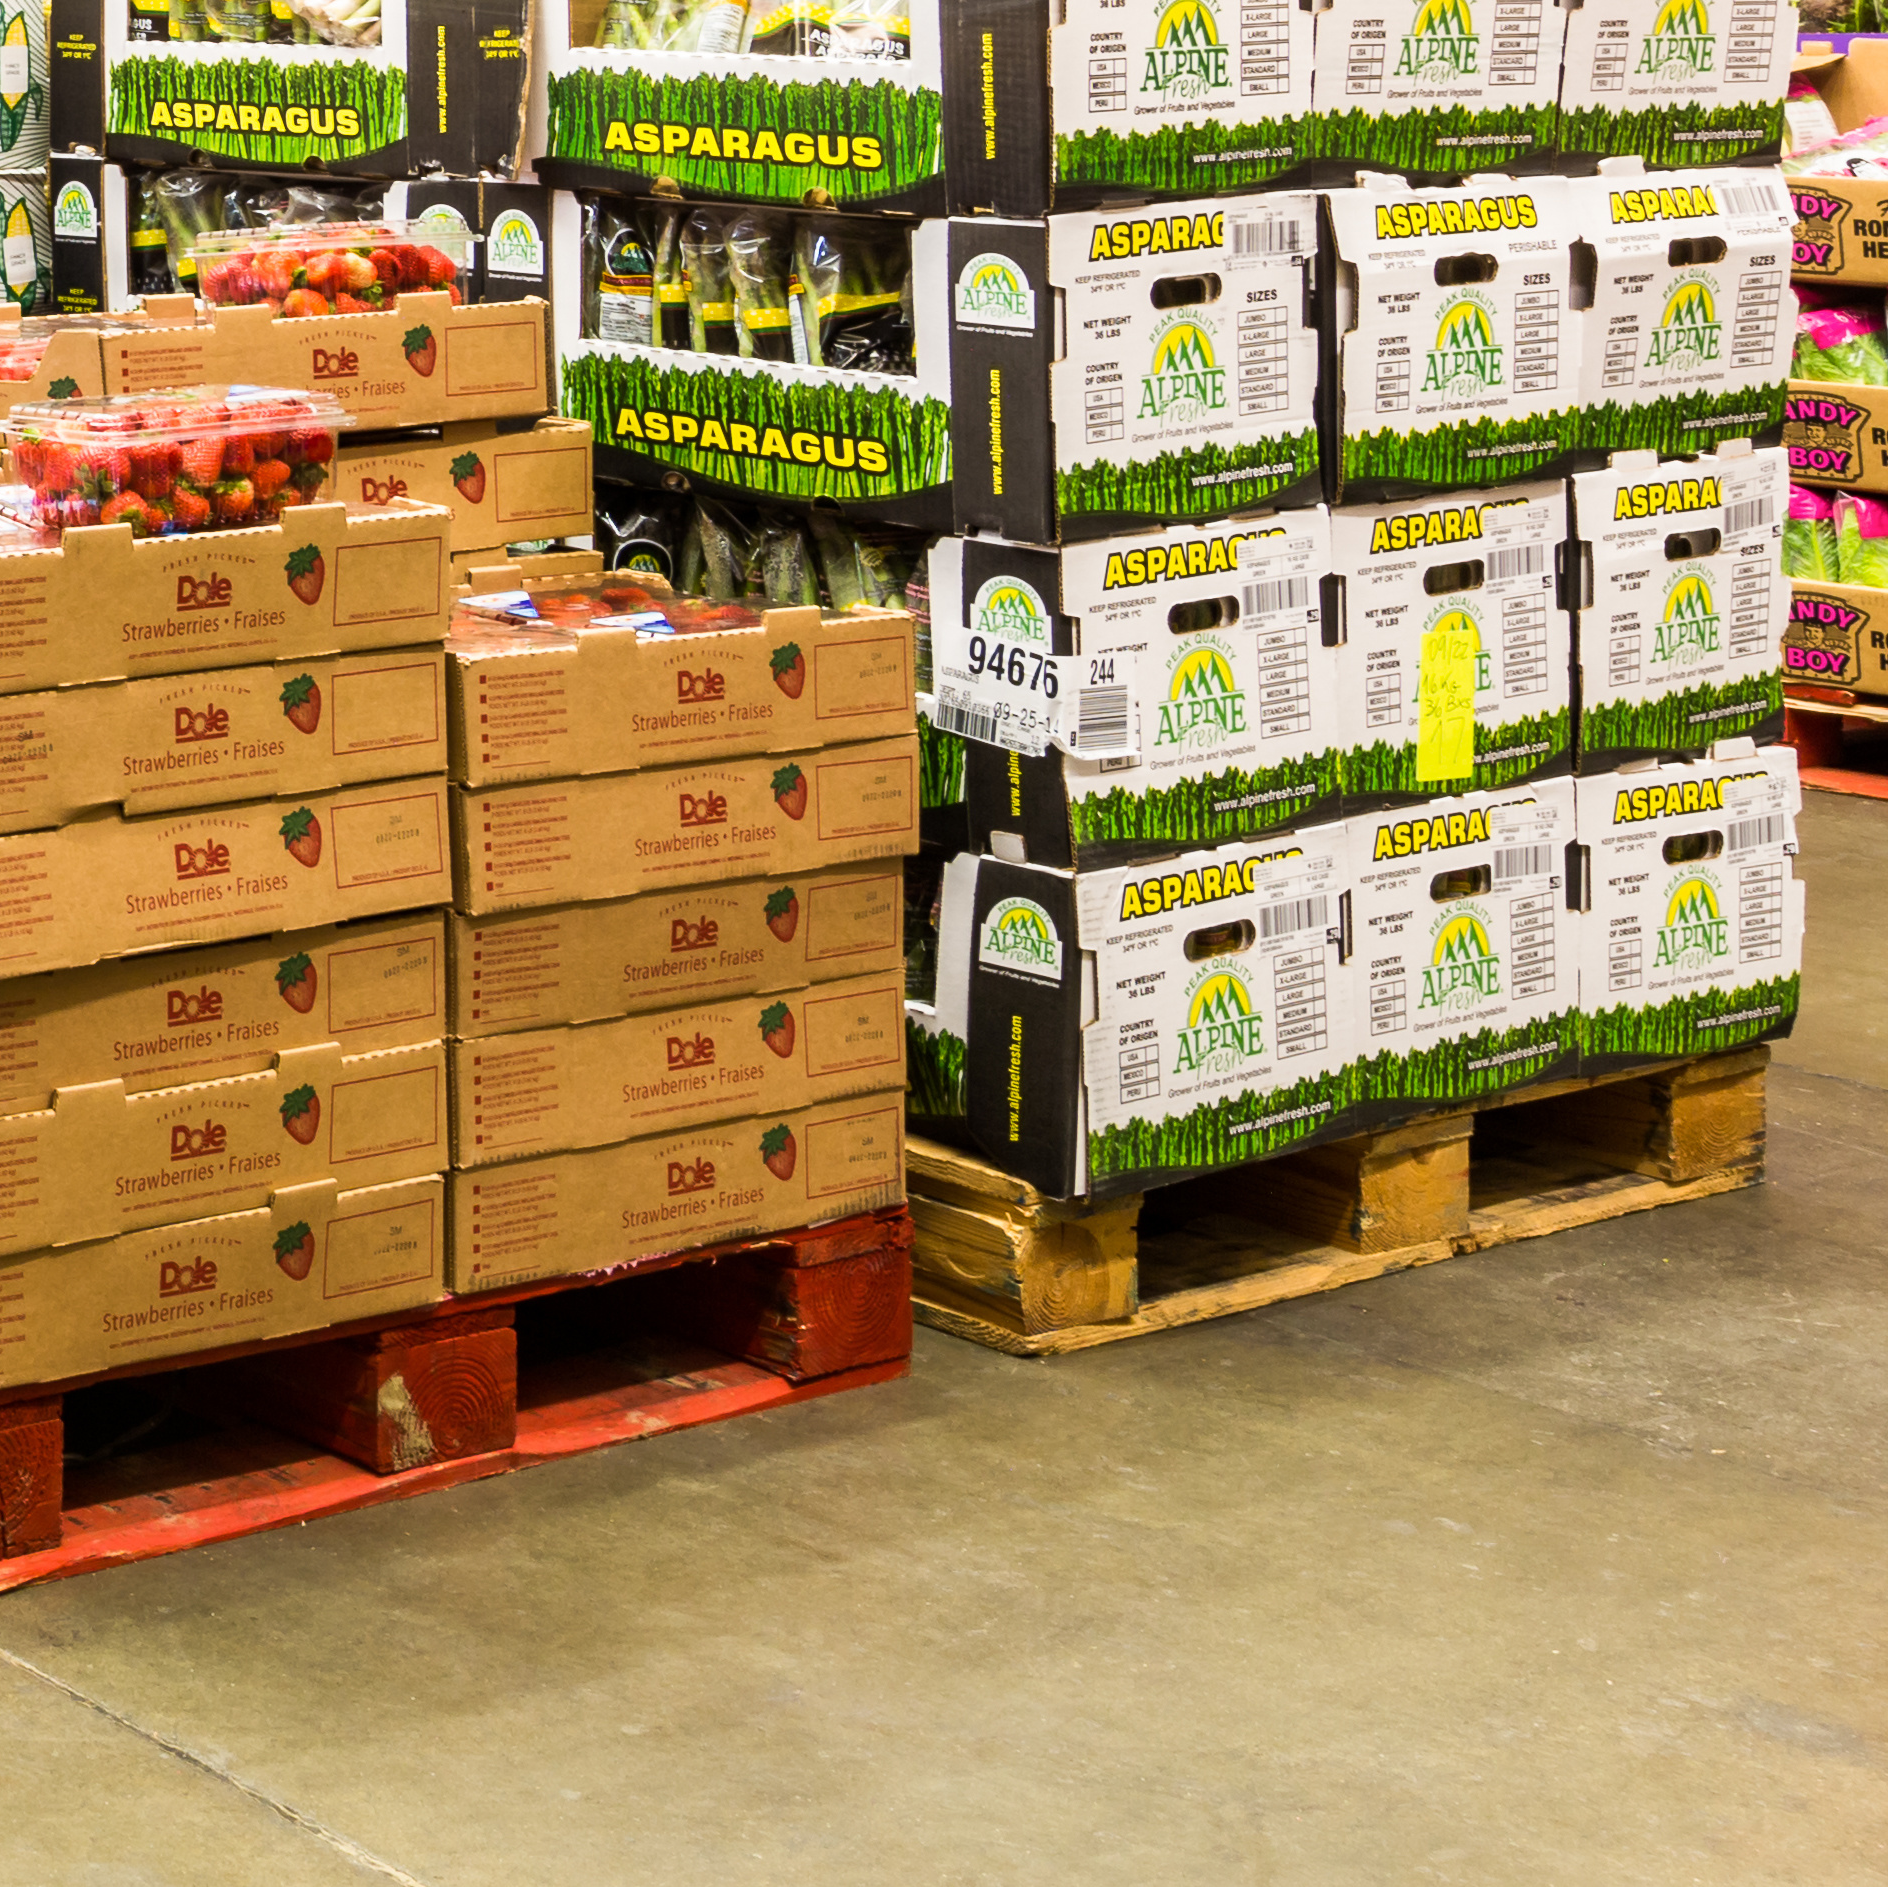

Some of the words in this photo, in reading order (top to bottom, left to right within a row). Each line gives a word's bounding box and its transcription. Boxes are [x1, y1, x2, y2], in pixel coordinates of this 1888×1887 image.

[605, 121, 882, 170] ASPARAGUS
[1375, 194, 1537, 239] ASPARAGUS
[1788, 445, 1852, 473] BOY
[177, 571, 232, 612] Dole
[122, 610, 220, 644] Strawberries
[233, 607, 286, 629] Fraises
[969, 635, 1059, 700] 94676
[1090, 658, 1115, 686] 244
[1006, 1014, 1023, 1143] www.alpinefresh.com
[667, 1157, 716, 1196] Dole
[621, 1200, 705, 1232] Strawberries
[717, 1184, 765, 1211] Fraises
